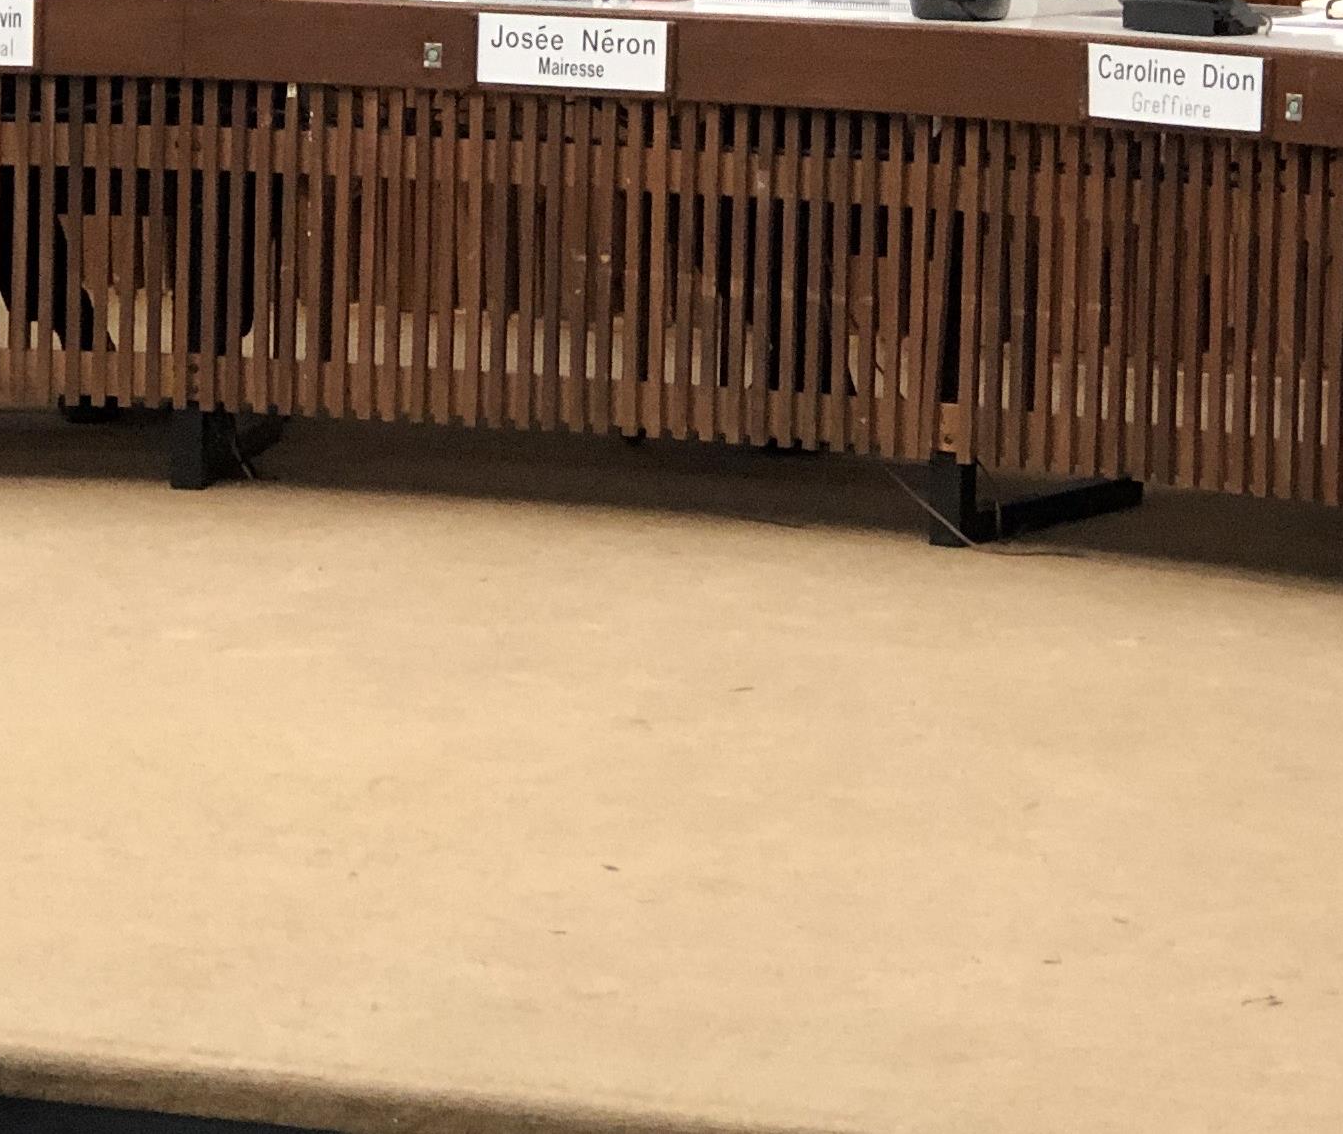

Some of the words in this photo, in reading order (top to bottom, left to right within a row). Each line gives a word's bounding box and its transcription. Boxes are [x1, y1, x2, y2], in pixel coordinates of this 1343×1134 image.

[491, 24, 564, 50] Josée
[582, 28, 655, 55] Néron
[538, 56, 604, 78] Mairesse
[1098, 54, 1186, 86] Caroline
[1203, 63, 1255, 91] Dion
[1132, 91, 1211, 119] Greffière
